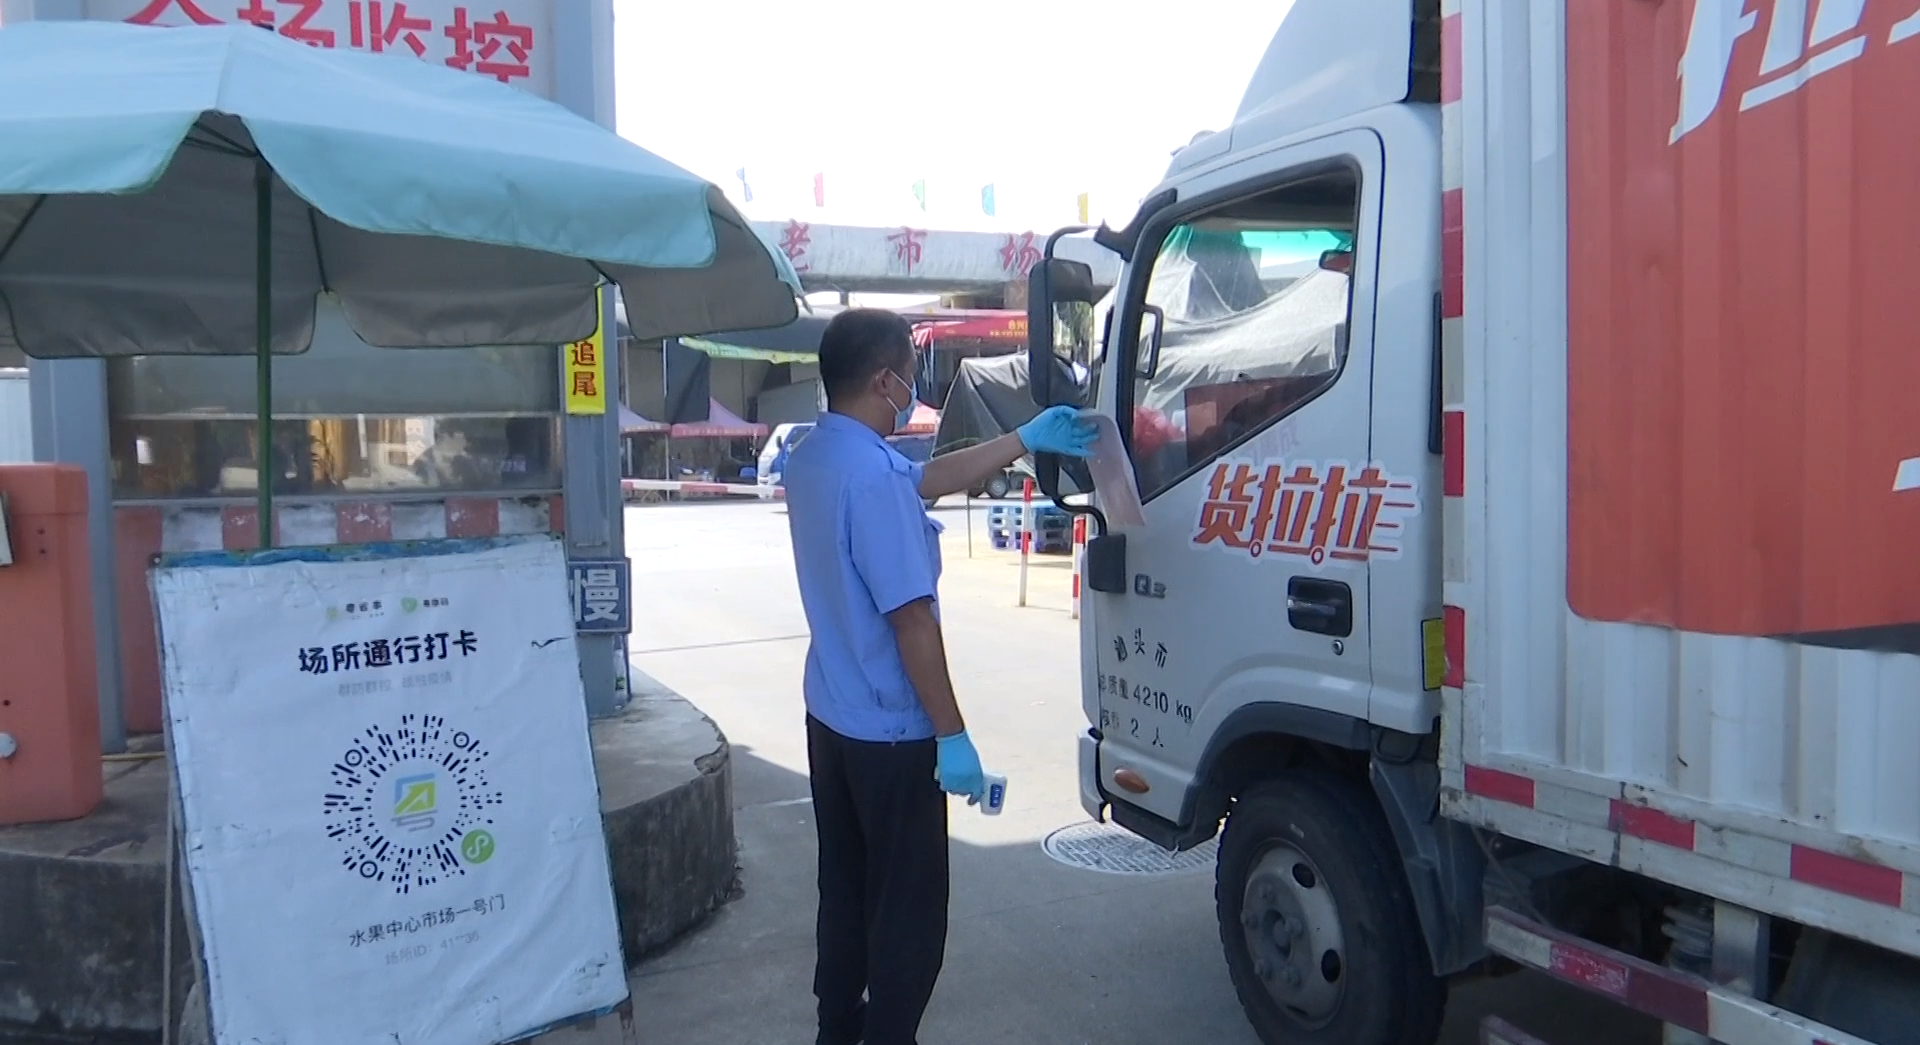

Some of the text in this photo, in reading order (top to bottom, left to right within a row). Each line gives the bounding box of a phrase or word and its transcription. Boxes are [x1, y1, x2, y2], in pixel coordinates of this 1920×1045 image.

[571, 341, 597, 396] 追尾
[1193, 463, 1388, 564] 货拉拉
[570, 569, 620, 621] 慢
[298, 629, 478, 676] 场所通行打卡
[1133, 683, 1169, 714] 4210
[1176, 699, 1193, 724] kg
[349, 893, 506, 948] 水果中心市场一号门
